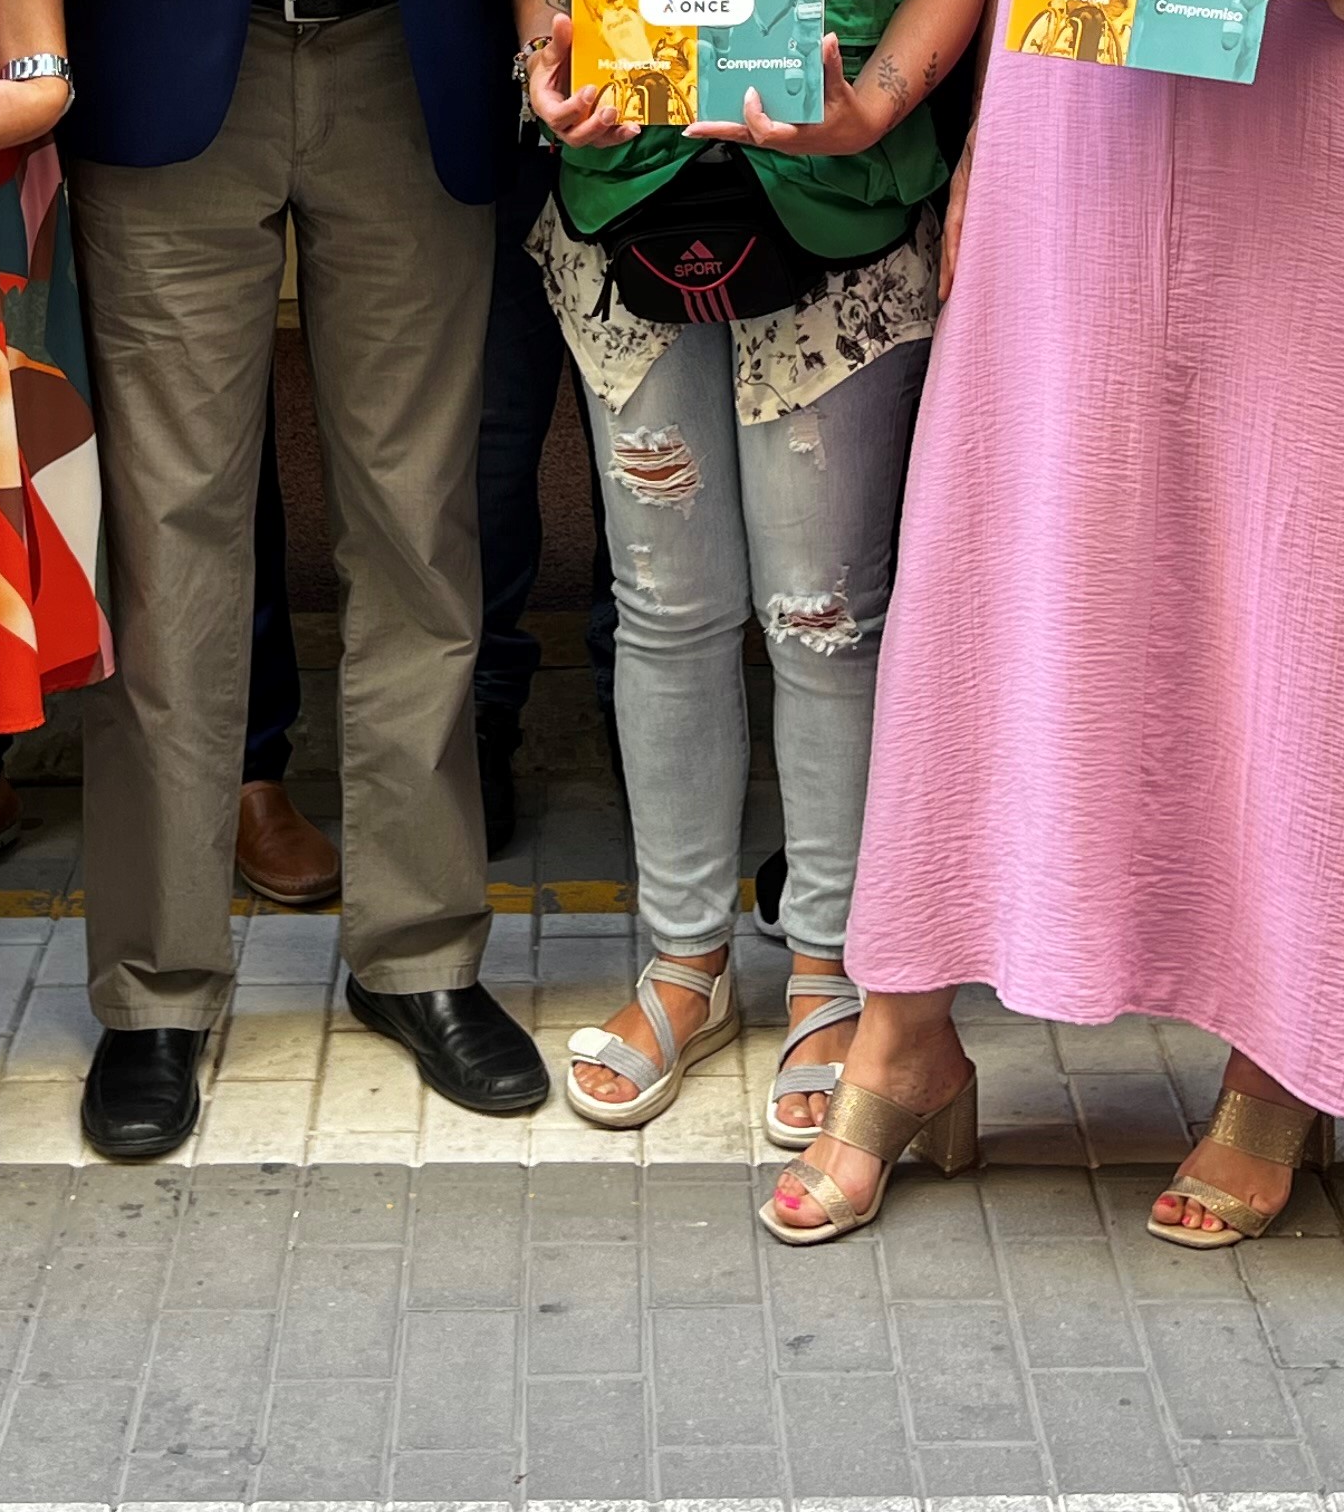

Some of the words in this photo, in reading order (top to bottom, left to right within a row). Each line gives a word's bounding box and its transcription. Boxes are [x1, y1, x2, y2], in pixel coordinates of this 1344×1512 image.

[680, 0, 730, 13] ONCE
[1156, 0, 1243, 23] Compromiso
[717, 56, 802, 71] Compromiso
[674, 262, 722, 277] SPORT
